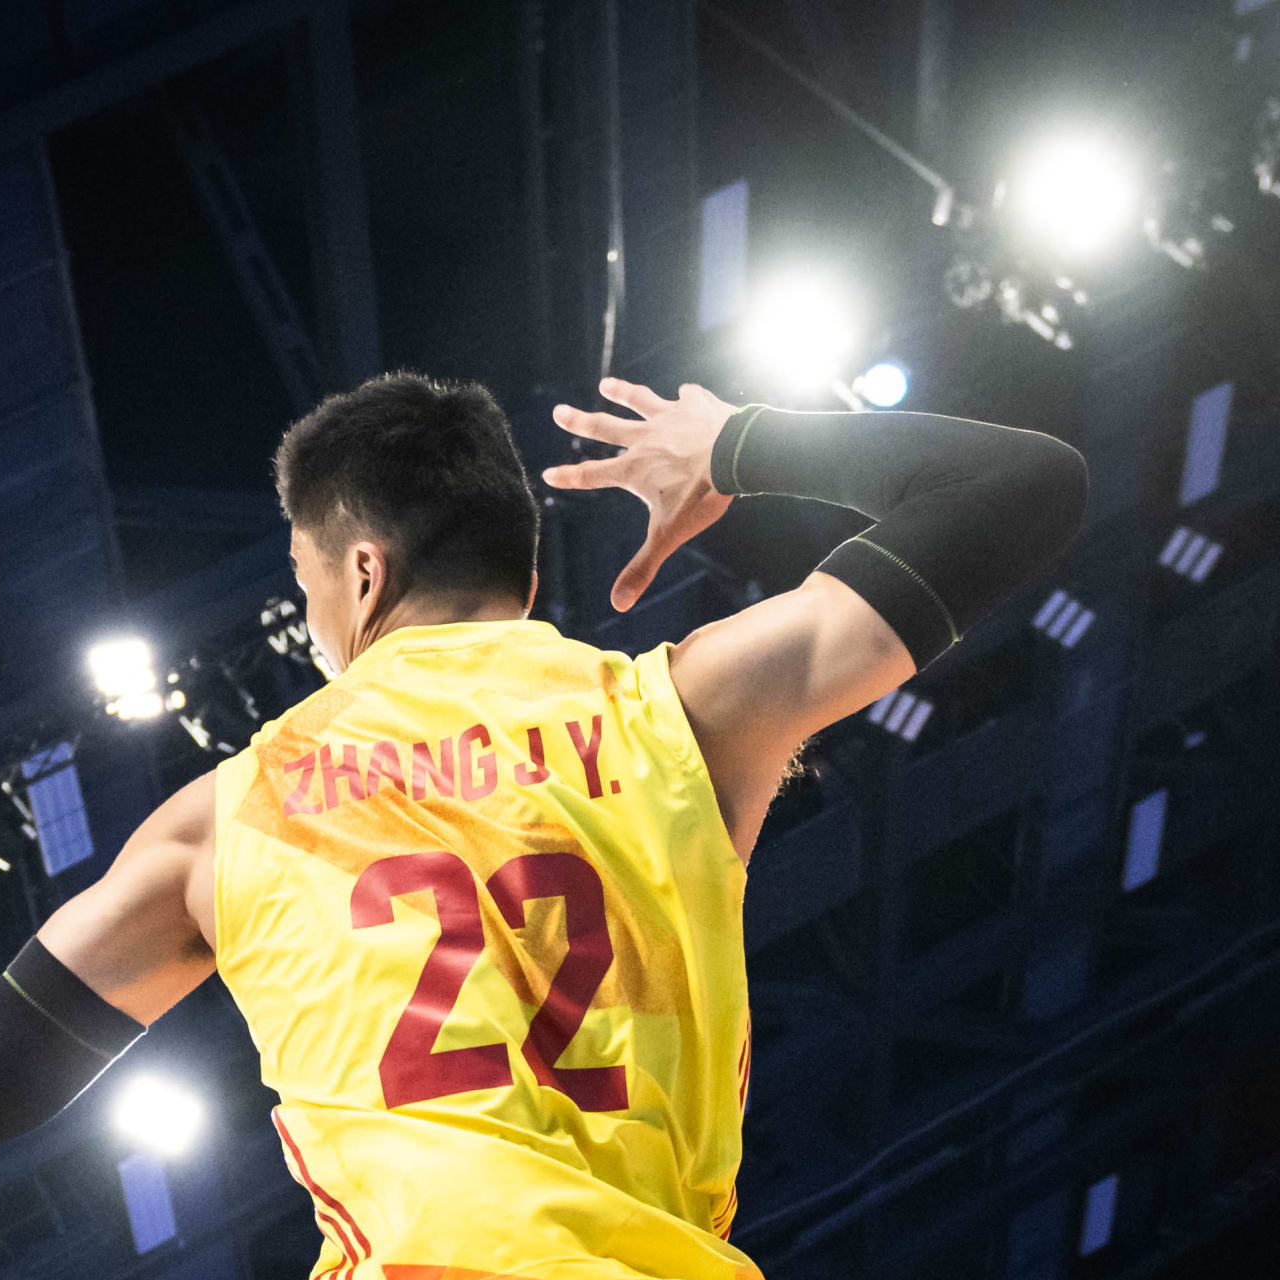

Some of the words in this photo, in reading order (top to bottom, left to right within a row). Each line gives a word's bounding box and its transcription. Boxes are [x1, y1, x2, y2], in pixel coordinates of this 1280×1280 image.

[281, 723, 498, 819] ZHANG
[514, 727, 551, 787] J
[565, 713, 622, 800] Y.
[349, 851, 630, 1113] 22
